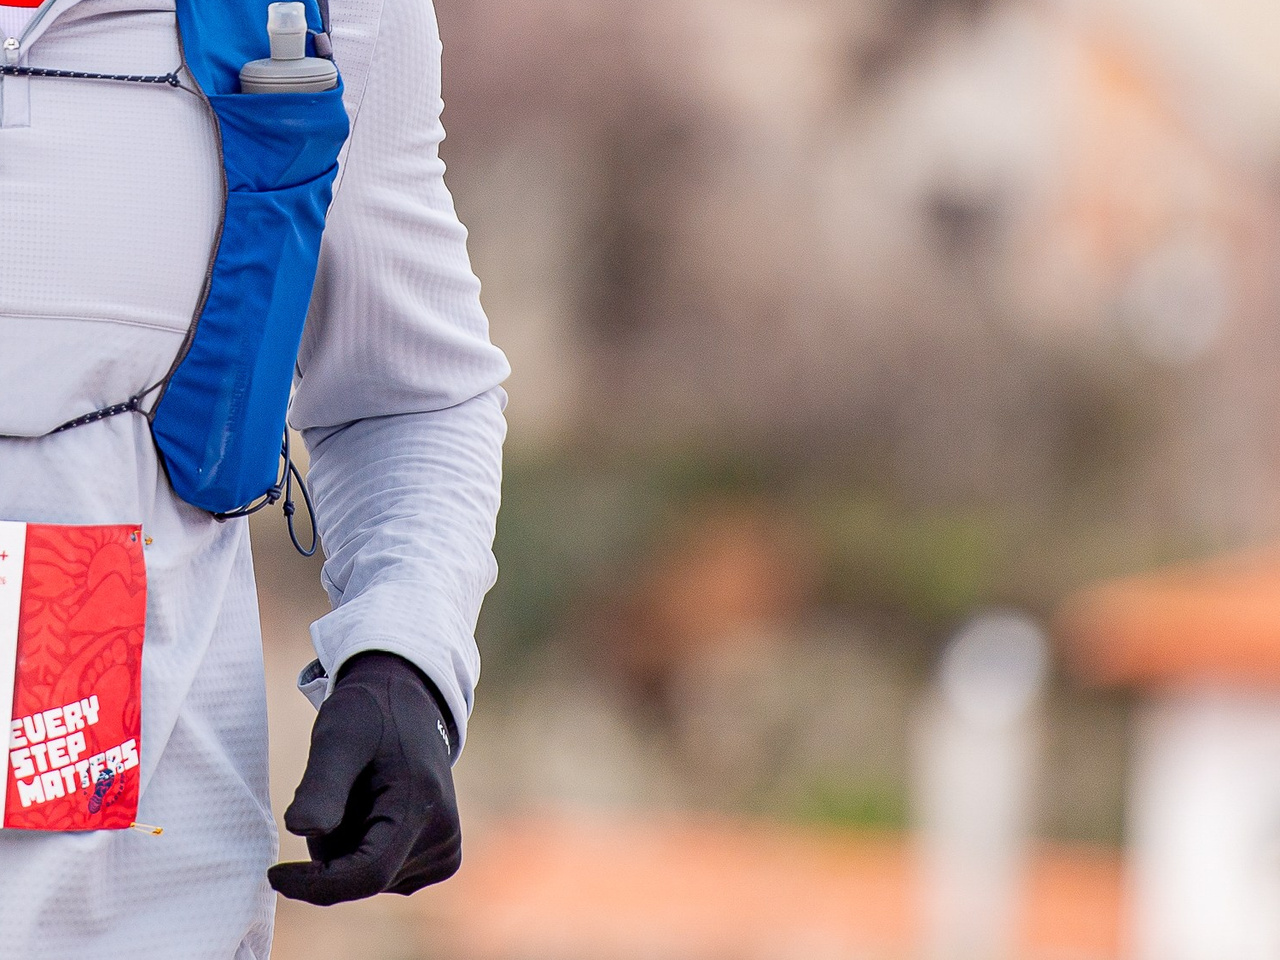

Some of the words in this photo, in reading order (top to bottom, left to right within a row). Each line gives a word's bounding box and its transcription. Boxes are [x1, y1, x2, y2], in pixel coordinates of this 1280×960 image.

[9, 695, 100, 749] EVERY
[9, 731, 87, 779] STEP
[16, 738, 140, 808] MATTERS
